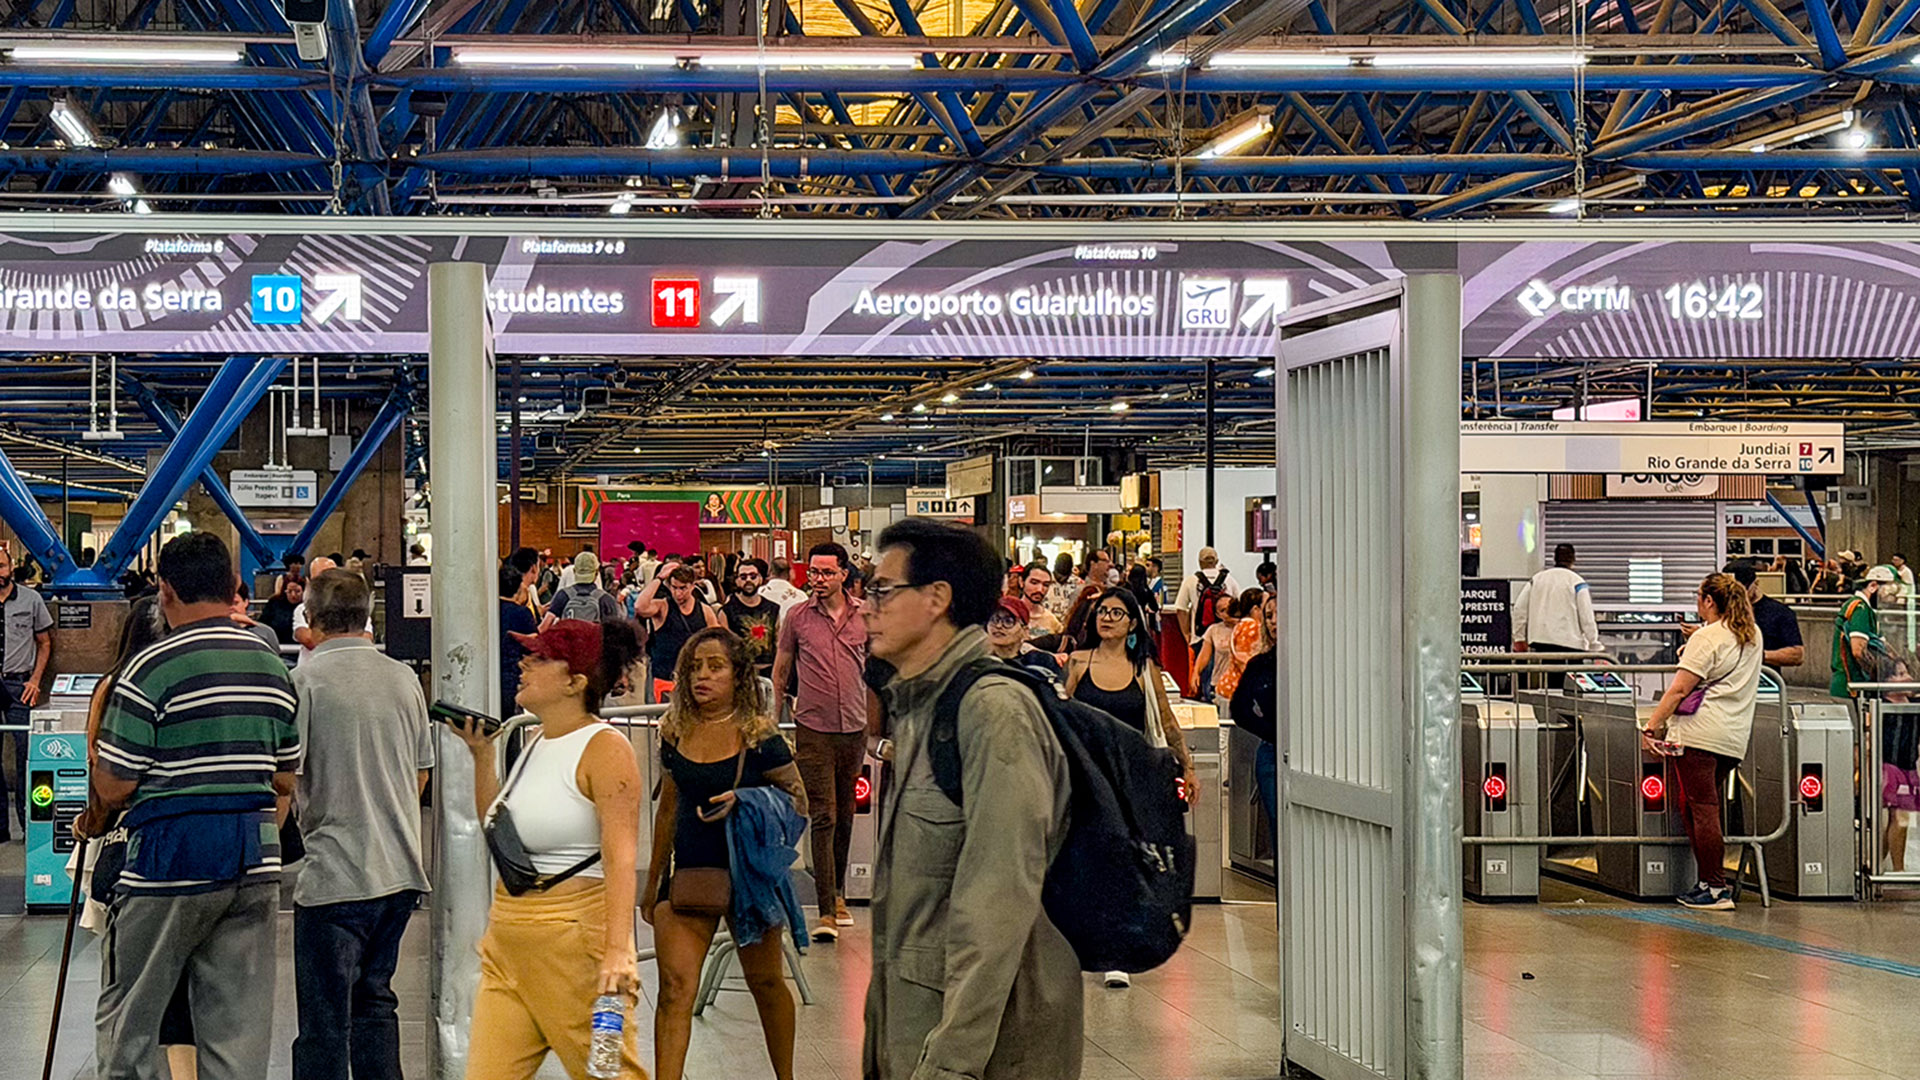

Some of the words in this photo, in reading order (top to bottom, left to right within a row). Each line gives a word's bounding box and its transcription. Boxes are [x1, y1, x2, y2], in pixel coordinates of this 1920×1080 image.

[145, 239, 211, 253] Plataforma
[213, 239, 224, 253] 6
[522, 239, 593, 254] Plataformas
[595, 240, 604, 254] 7
[605, 244, 614, 254] e
[615, 240, 625, 254] 8
[1074, 246, 1139, 260] Plataforma
[1140, 246, 1156, 260] 10
[0, 279, 91, 310] rande
[99, 279, 137, 310] da
[145, 282, 223, 311] Serra
[257, 286, 296, 312] 10
[488, 285, 624, 314] studantes
[658, 287, 694, 317] 11
[1560, 286, 1630, 311] CPTM
[1664, 283, 1763, 319] 16:42
[852, 289, 1001, 320] Aeroporto
[1009, 288, 1155, 316] Guarulhos
[1186, 308, 1227, 324] GRU
[1520, 422, 1560, 431] Transfer
[1689, 423, 1737, 433] Embarque
[1745, 423, 1789, 433] Boarding
[1739, 443, 1791, 455] Jundiaí
[1802, 444, 1810, 455] 7
[1648, 457, 1671, 469] Rio
[1675, 457, 1728, 469] Grande
[1732, 457, 1745, 469] da
[1754, 457, 1791, 469] Serra
[1801, 459, 1812, 470] 10
[1460, 590, 1497, 599] BARQUE
[1465, 603, 1505, 611] PRESTES
[1460, 615, 1492, 623] TAPEVI
[1461, 633, 1487, 641] TILIZE
